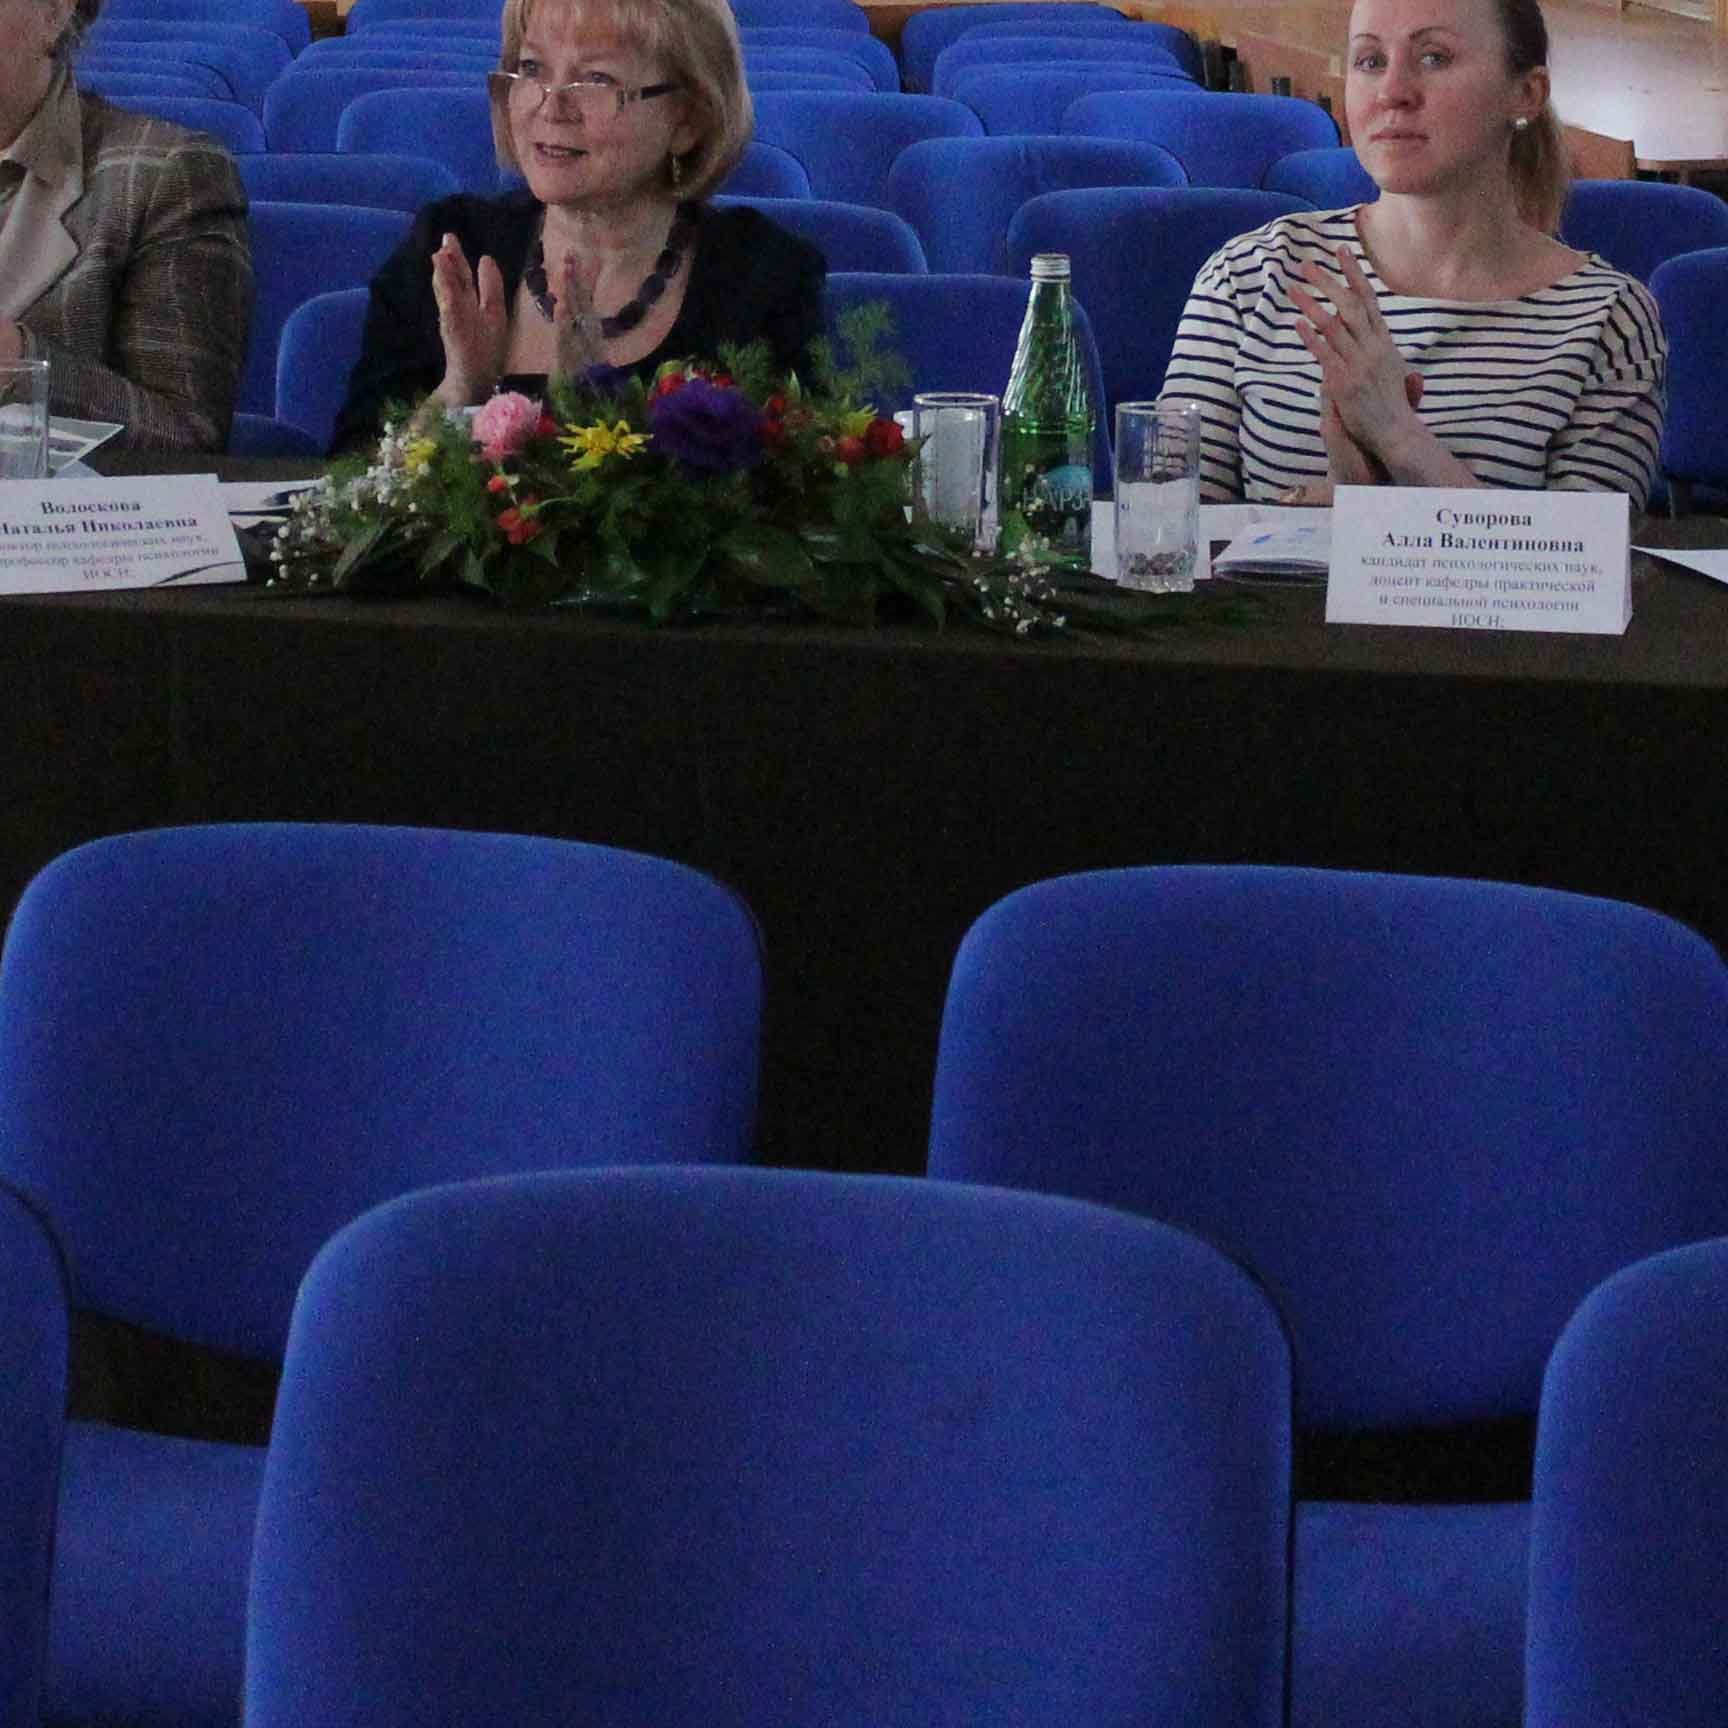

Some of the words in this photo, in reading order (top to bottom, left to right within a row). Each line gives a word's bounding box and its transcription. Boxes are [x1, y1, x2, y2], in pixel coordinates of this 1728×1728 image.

[41, 500, 142, 515] Волоскова
[82, 516, 198, 533] Николаевна
[1436, 508, 1532, 528] Суворова
[1382, 532, 1432, 549] Алла
[1440, 533, 1584, 553] Валентиновна
[1361, 556, 1426, 570] кандидат
[1432, 559, 1559, 575] психологических
[1371, 576, 1419, 589] доцент
[1425, 577, 1488, 592] кафедры
[1494, 579, 1595, 594] практической
[1392, 595, 1487, 610] специальной
[1492, 599, 1579, 613] психологии
